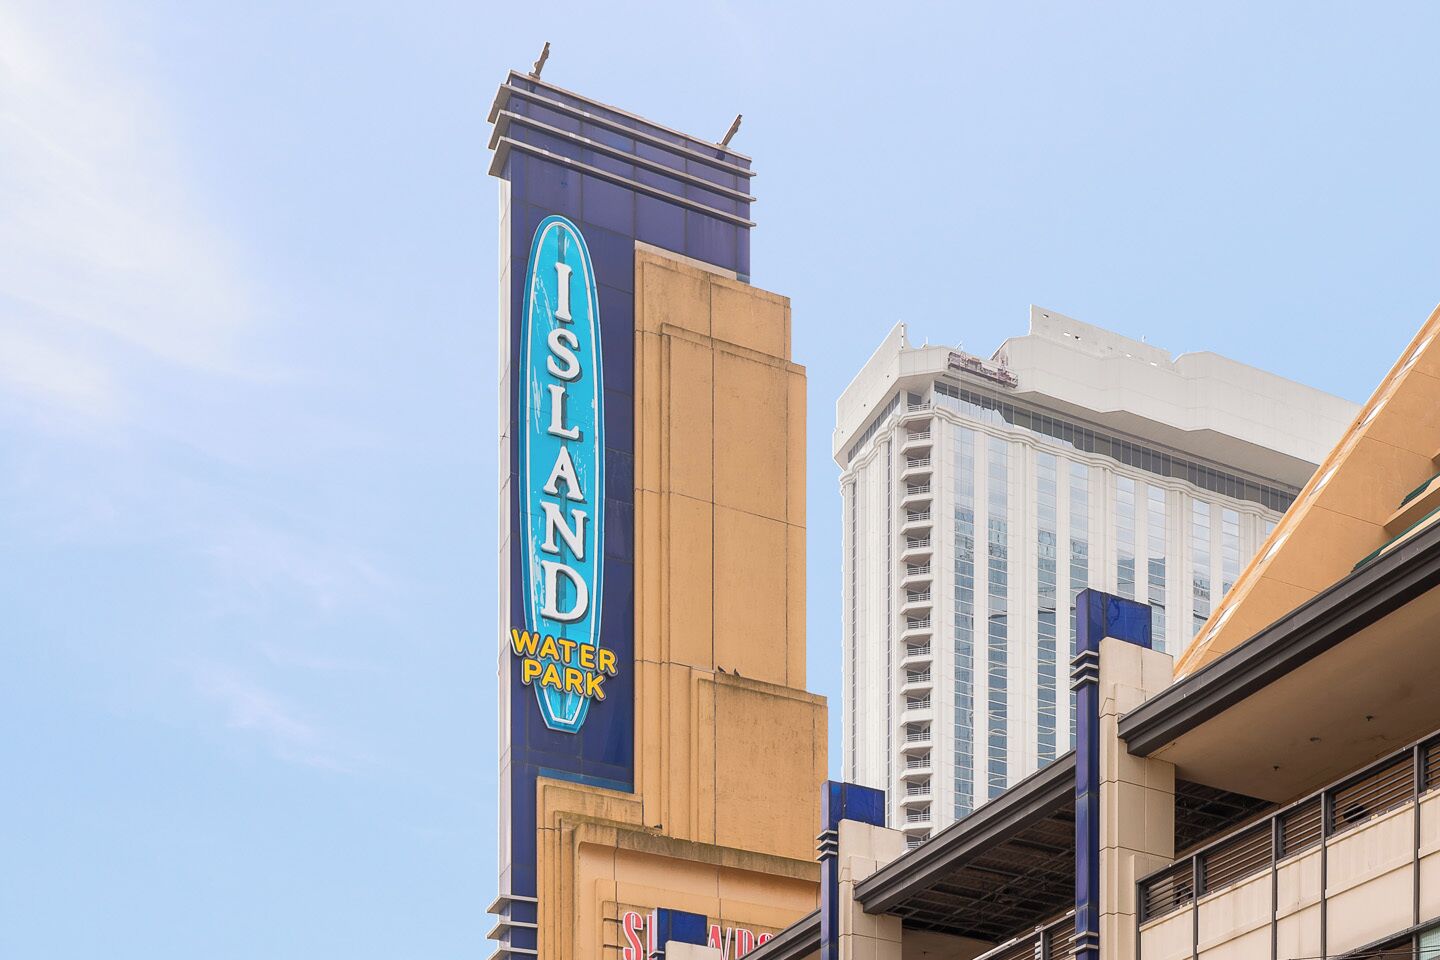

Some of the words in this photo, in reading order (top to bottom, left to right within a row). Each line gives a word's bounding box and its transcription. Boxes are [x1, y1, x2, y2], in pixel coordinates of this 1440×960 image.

[541, 262, 588, 622] ISLAND
[510, 628, 618, 675] WATER
[522, 658, 606, 700] PARK
